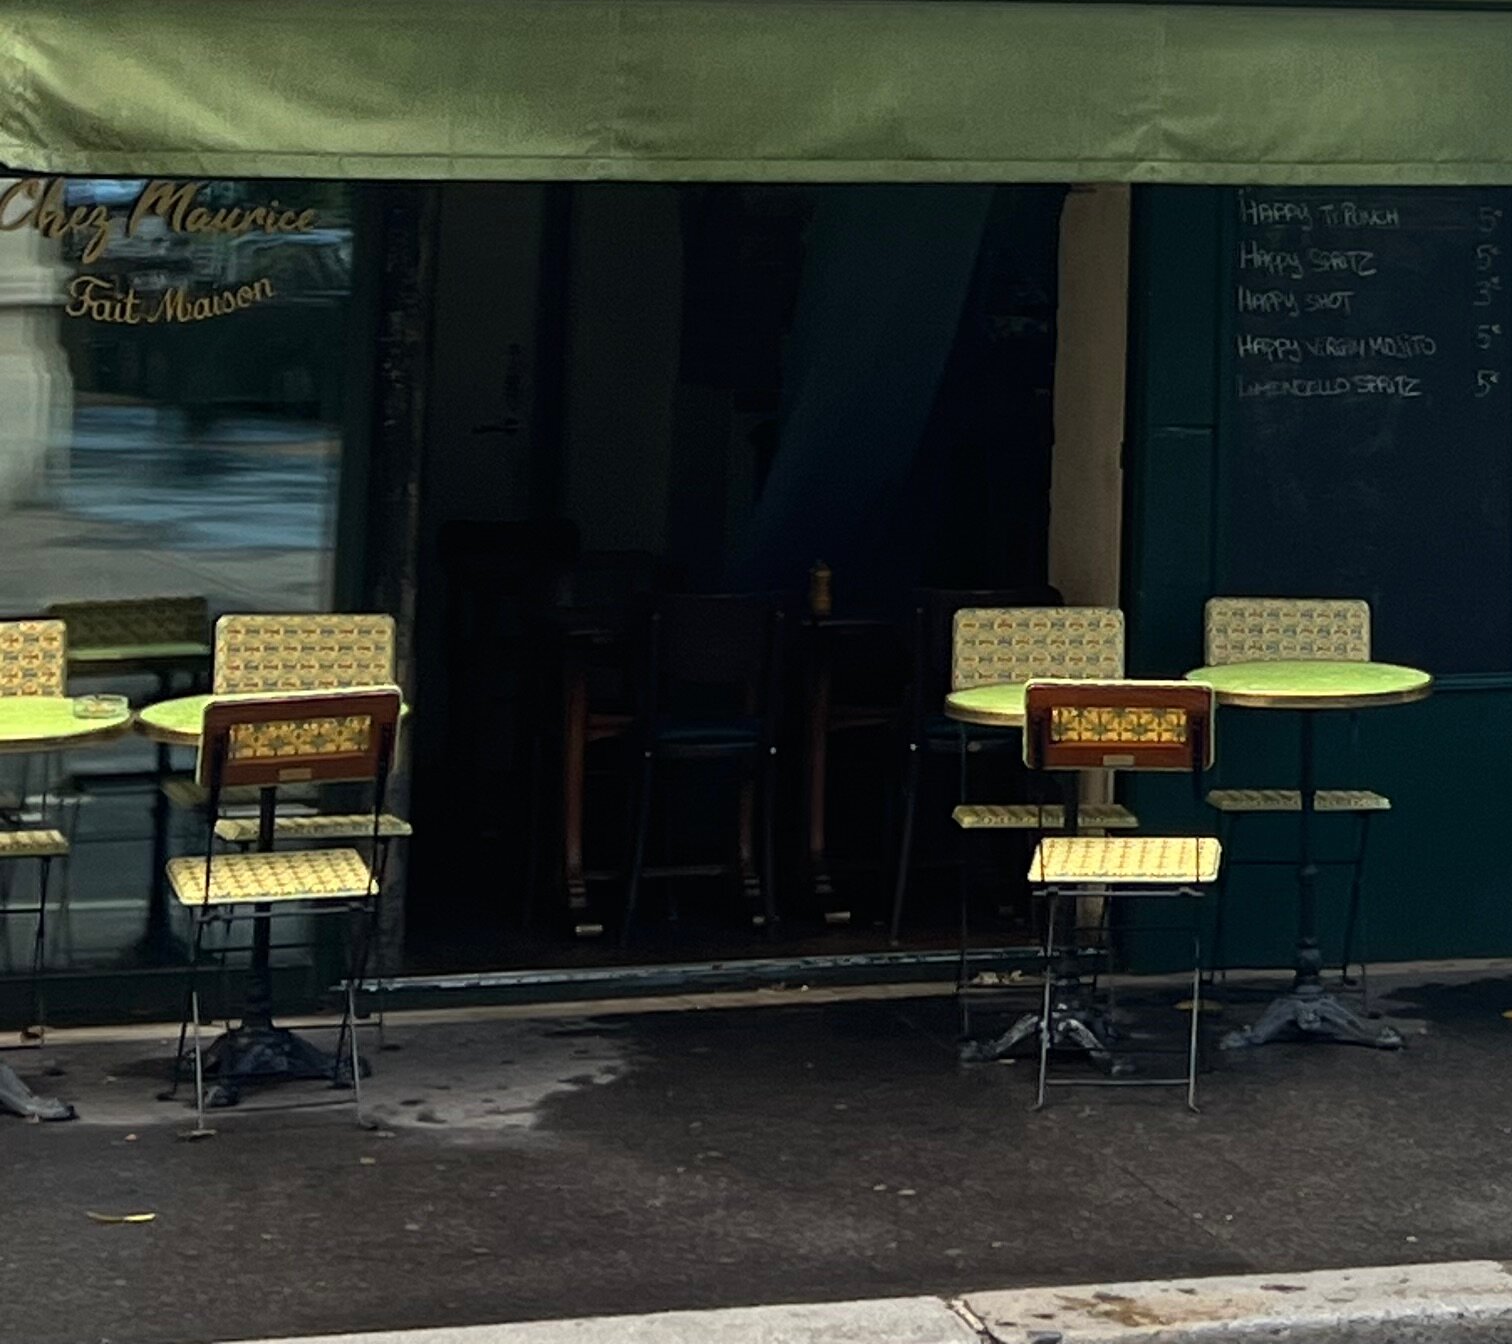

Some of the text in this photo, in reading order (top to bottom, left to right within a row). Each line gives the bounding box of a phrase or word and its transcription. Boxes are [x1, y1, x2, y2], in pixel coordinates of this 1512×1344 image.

[0, 177, 321, 265] Chez Maurice
[64, 274, 278, 325] Fait Maison
[1304, 290, 1355, 316] SHOT
